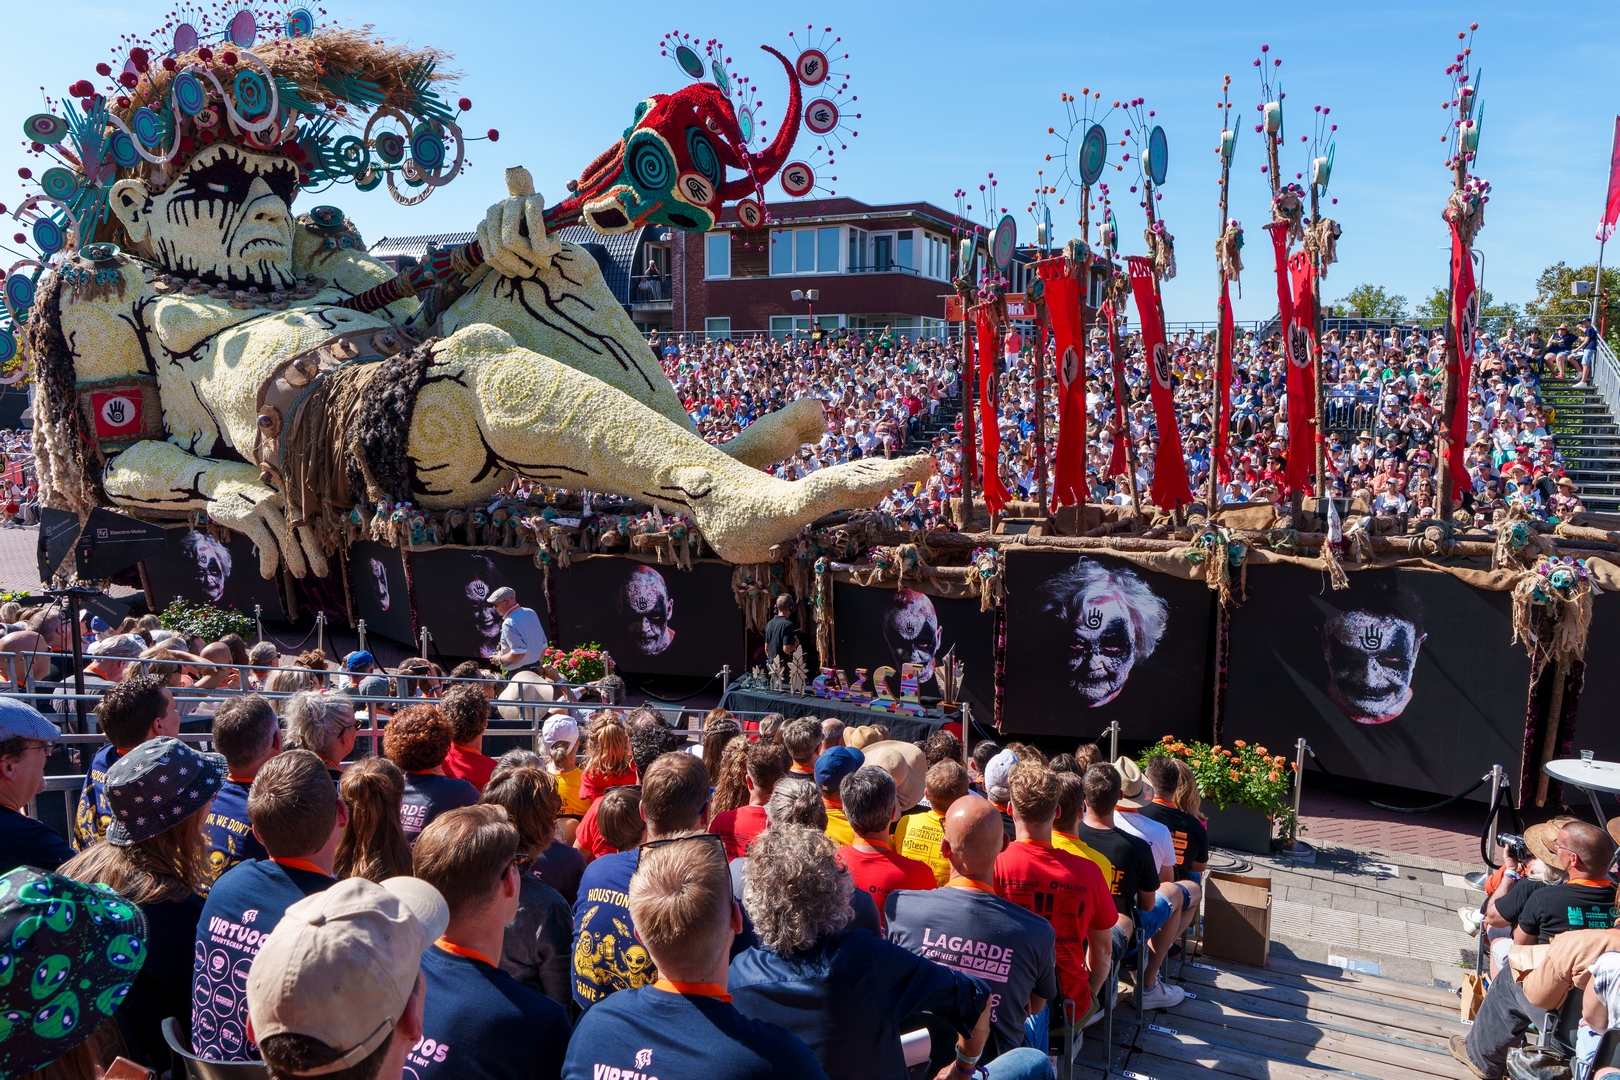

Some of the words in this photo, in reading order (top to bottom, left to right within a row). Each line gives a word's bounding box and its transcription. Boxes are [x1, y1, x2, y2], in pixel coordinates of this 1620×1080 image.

[216, 814, 227, 829] WE
[227, 818, 252, 837] DON'T
[903, 840, 929, 852] Mjtech
[1059, 882, 1088, 893] MAUSER
[921, 946, 959, 962] TECHNIEK
[922, 927, 1014, 963] LAGARDE
[576, 979, 597, 1003] HAVE
